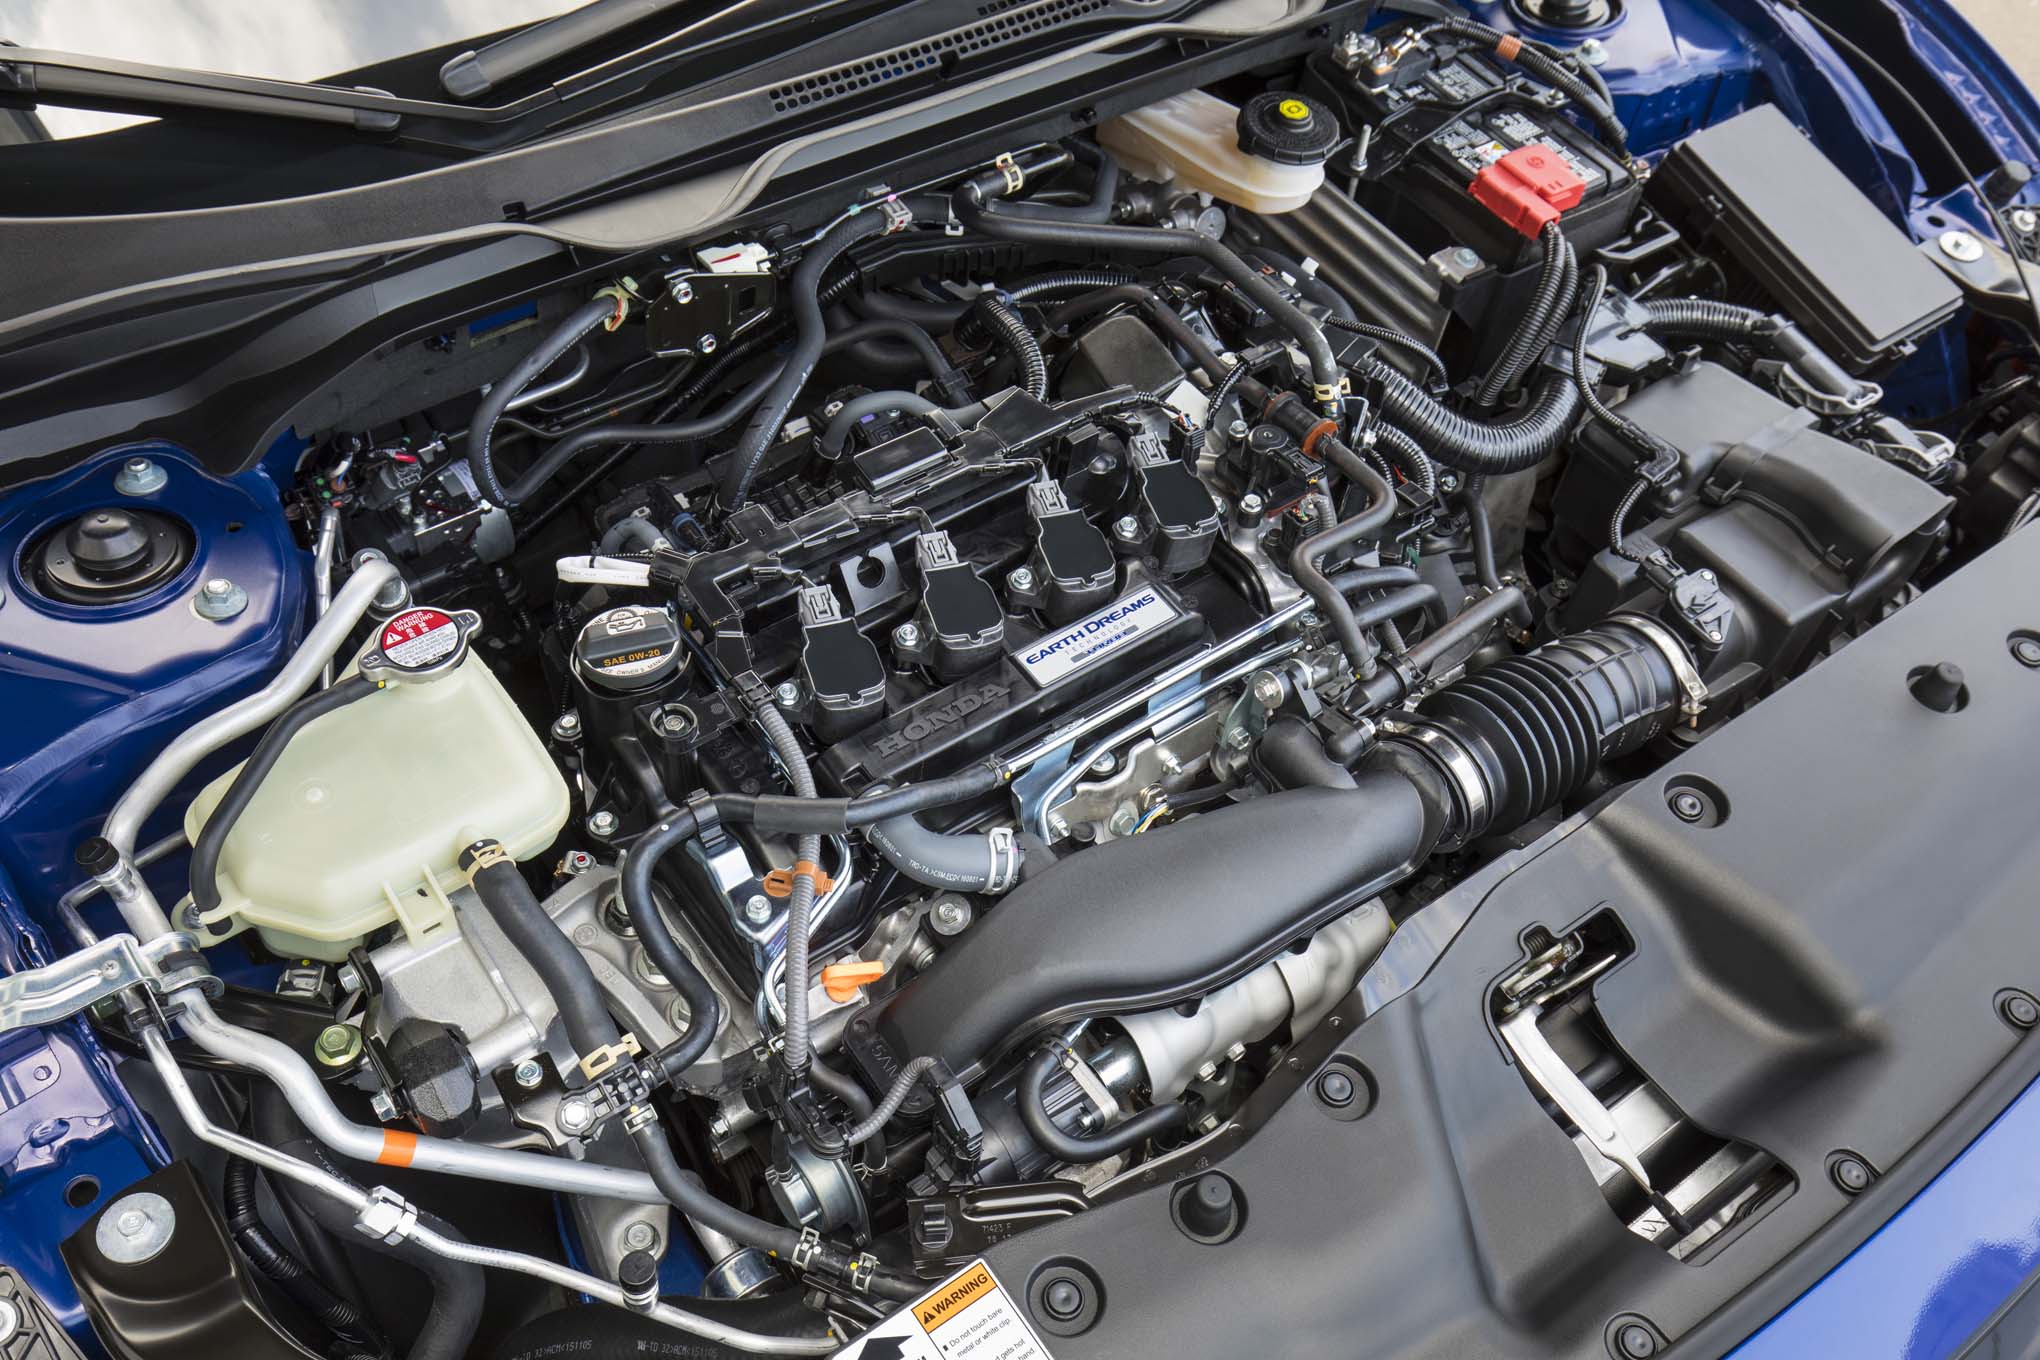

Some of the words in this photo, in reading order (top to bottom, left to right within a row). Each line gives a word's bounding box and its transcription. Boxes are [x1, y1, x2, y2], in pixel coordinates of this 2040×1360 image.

[393, 611, 423, 627] DANGER
[396, 613, 434, 632] WARNUNG
[1026, 630, 1085, 666] EARTH
[1083, 593, 1156, 634] DREAMS
[1065, 618, 1131, 655] TECHNOLOGY
[604, 655, 626, 667] SAE
[629, 649, 660, 661] 0W-20
[873, 682, 1012, 758] HONDA
[932, 1273, 989, 1315] WARNING
[949, 1338, 960, 1348] Do
[960, 1330, 971, 1341] not
[971, 1318, 988, 1333] touch
[987, 1307, 1003, 1320] bare
[957, 1342, 975, 1358] metal
[975, 1337, 982, 1346] or
[982, 1325, 999, 1340] white
[1001, 1346, 1014, 1360] gets
[1013, 1338, 1026, 1349] hot
